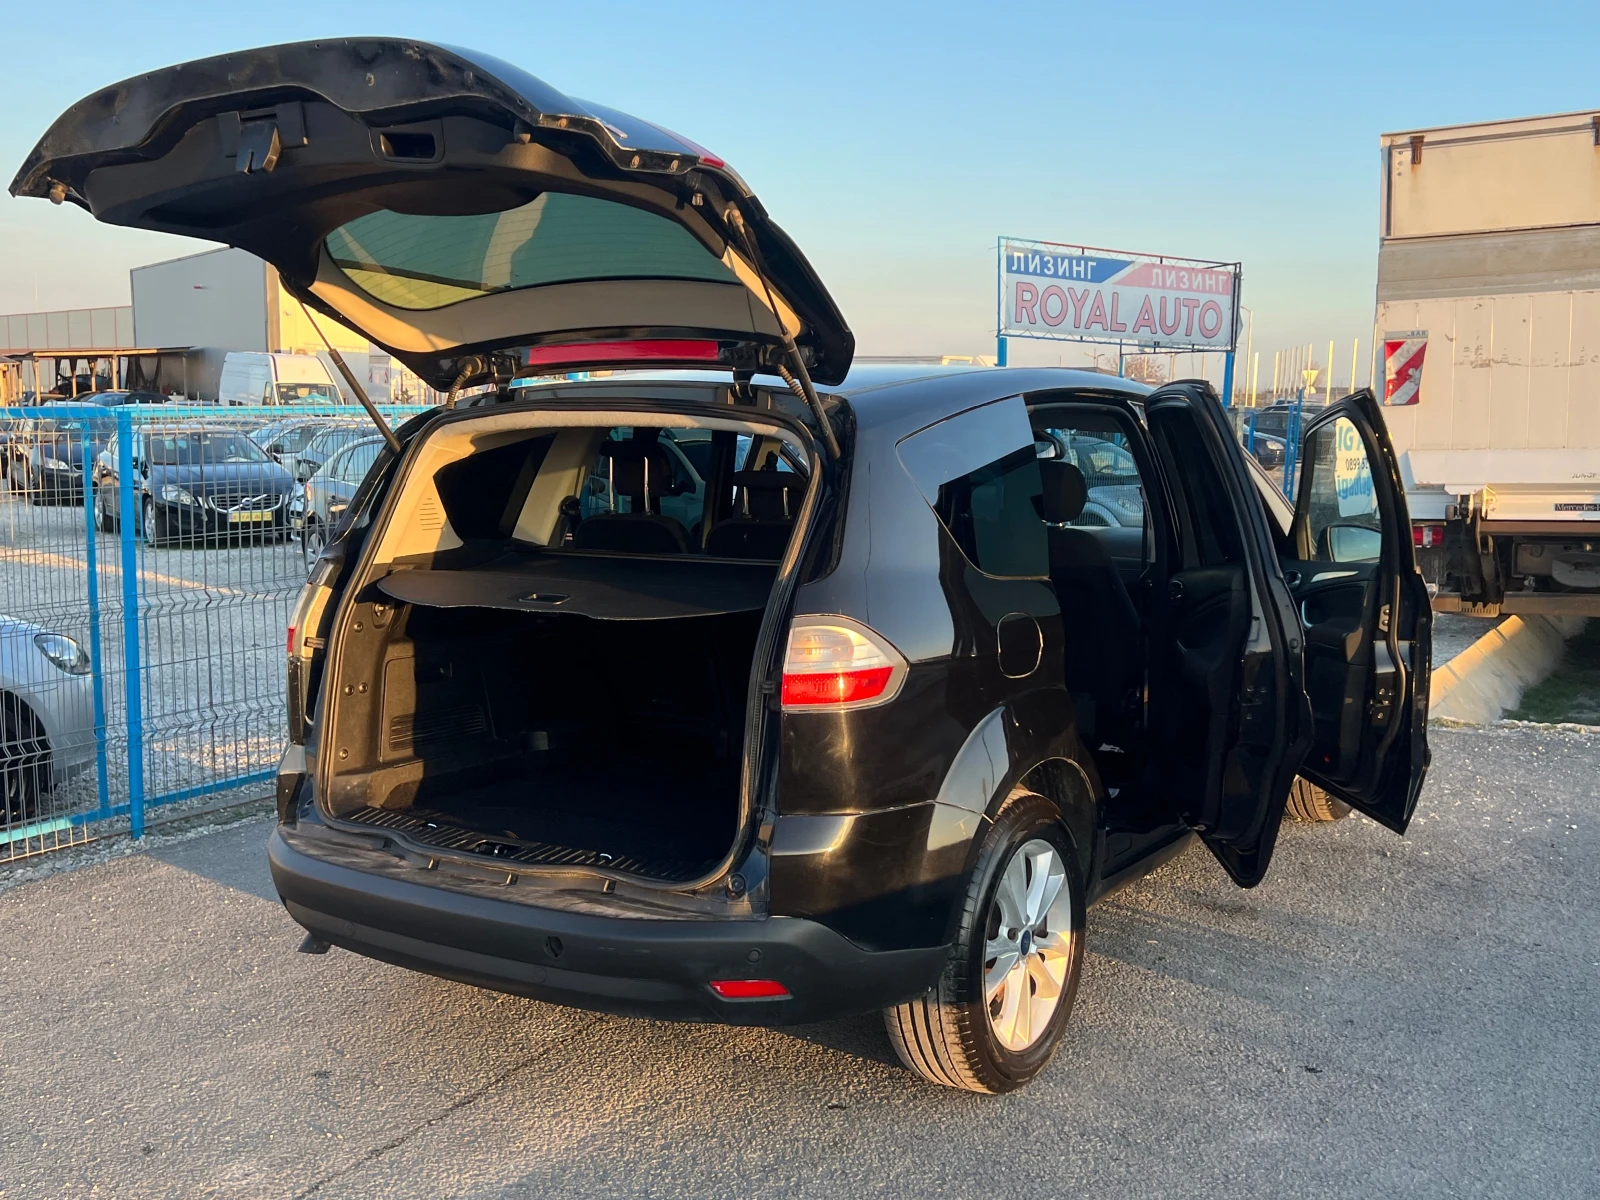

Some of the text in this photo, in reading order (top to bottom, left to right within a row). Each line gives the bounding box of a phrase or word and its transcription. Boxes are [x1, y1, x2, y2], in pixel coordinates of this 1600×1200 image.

[1012, 252, 1096, 280] ЛИЗИНГ
[1151, 268, 1228, 293] ЛИЗИНГ
[1015, 282, 1223, 339] ROYAL AUTO
[1338, 426, 1354, 452] IG
[1345, 457, 1360, 471] 0899
